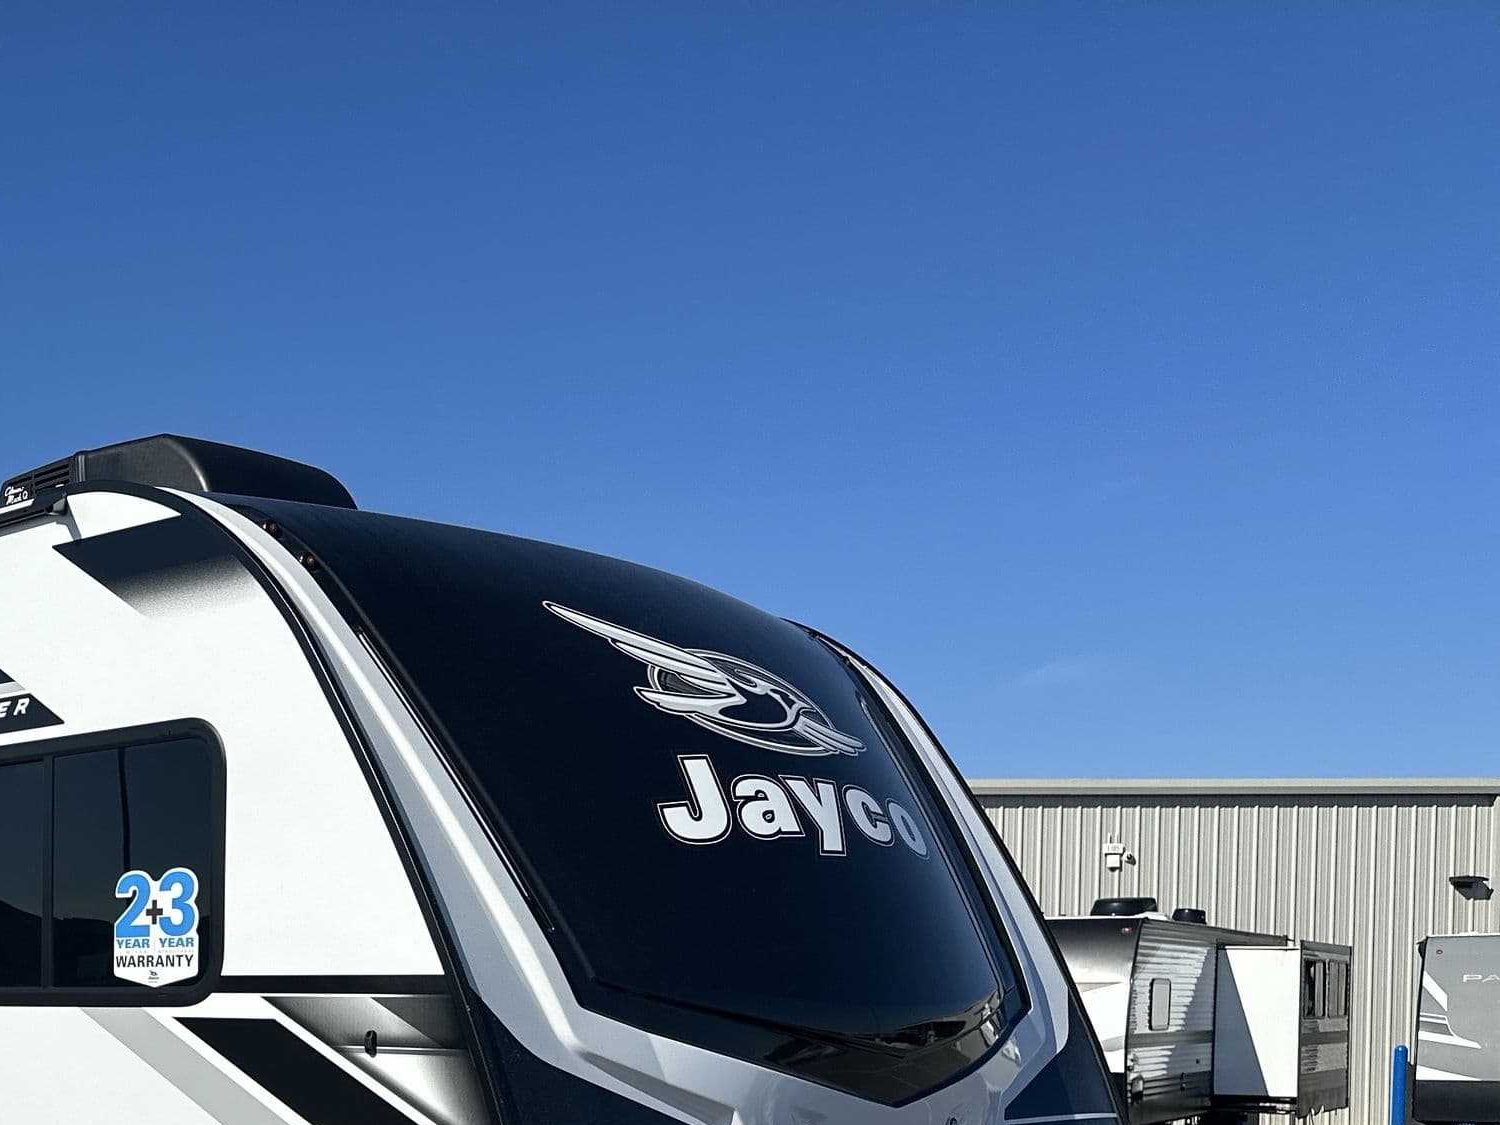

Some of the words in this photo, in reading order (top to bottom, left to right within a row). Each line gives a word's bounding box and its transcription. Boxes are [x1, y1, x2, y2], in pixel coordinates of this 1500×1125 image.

[657, 754, 931, 860] Jayco
[116, 938, 150, 949] YEAR
[159, 937, 195, 948] YEAR
[115, 954, 195, 968] WARRANTY
